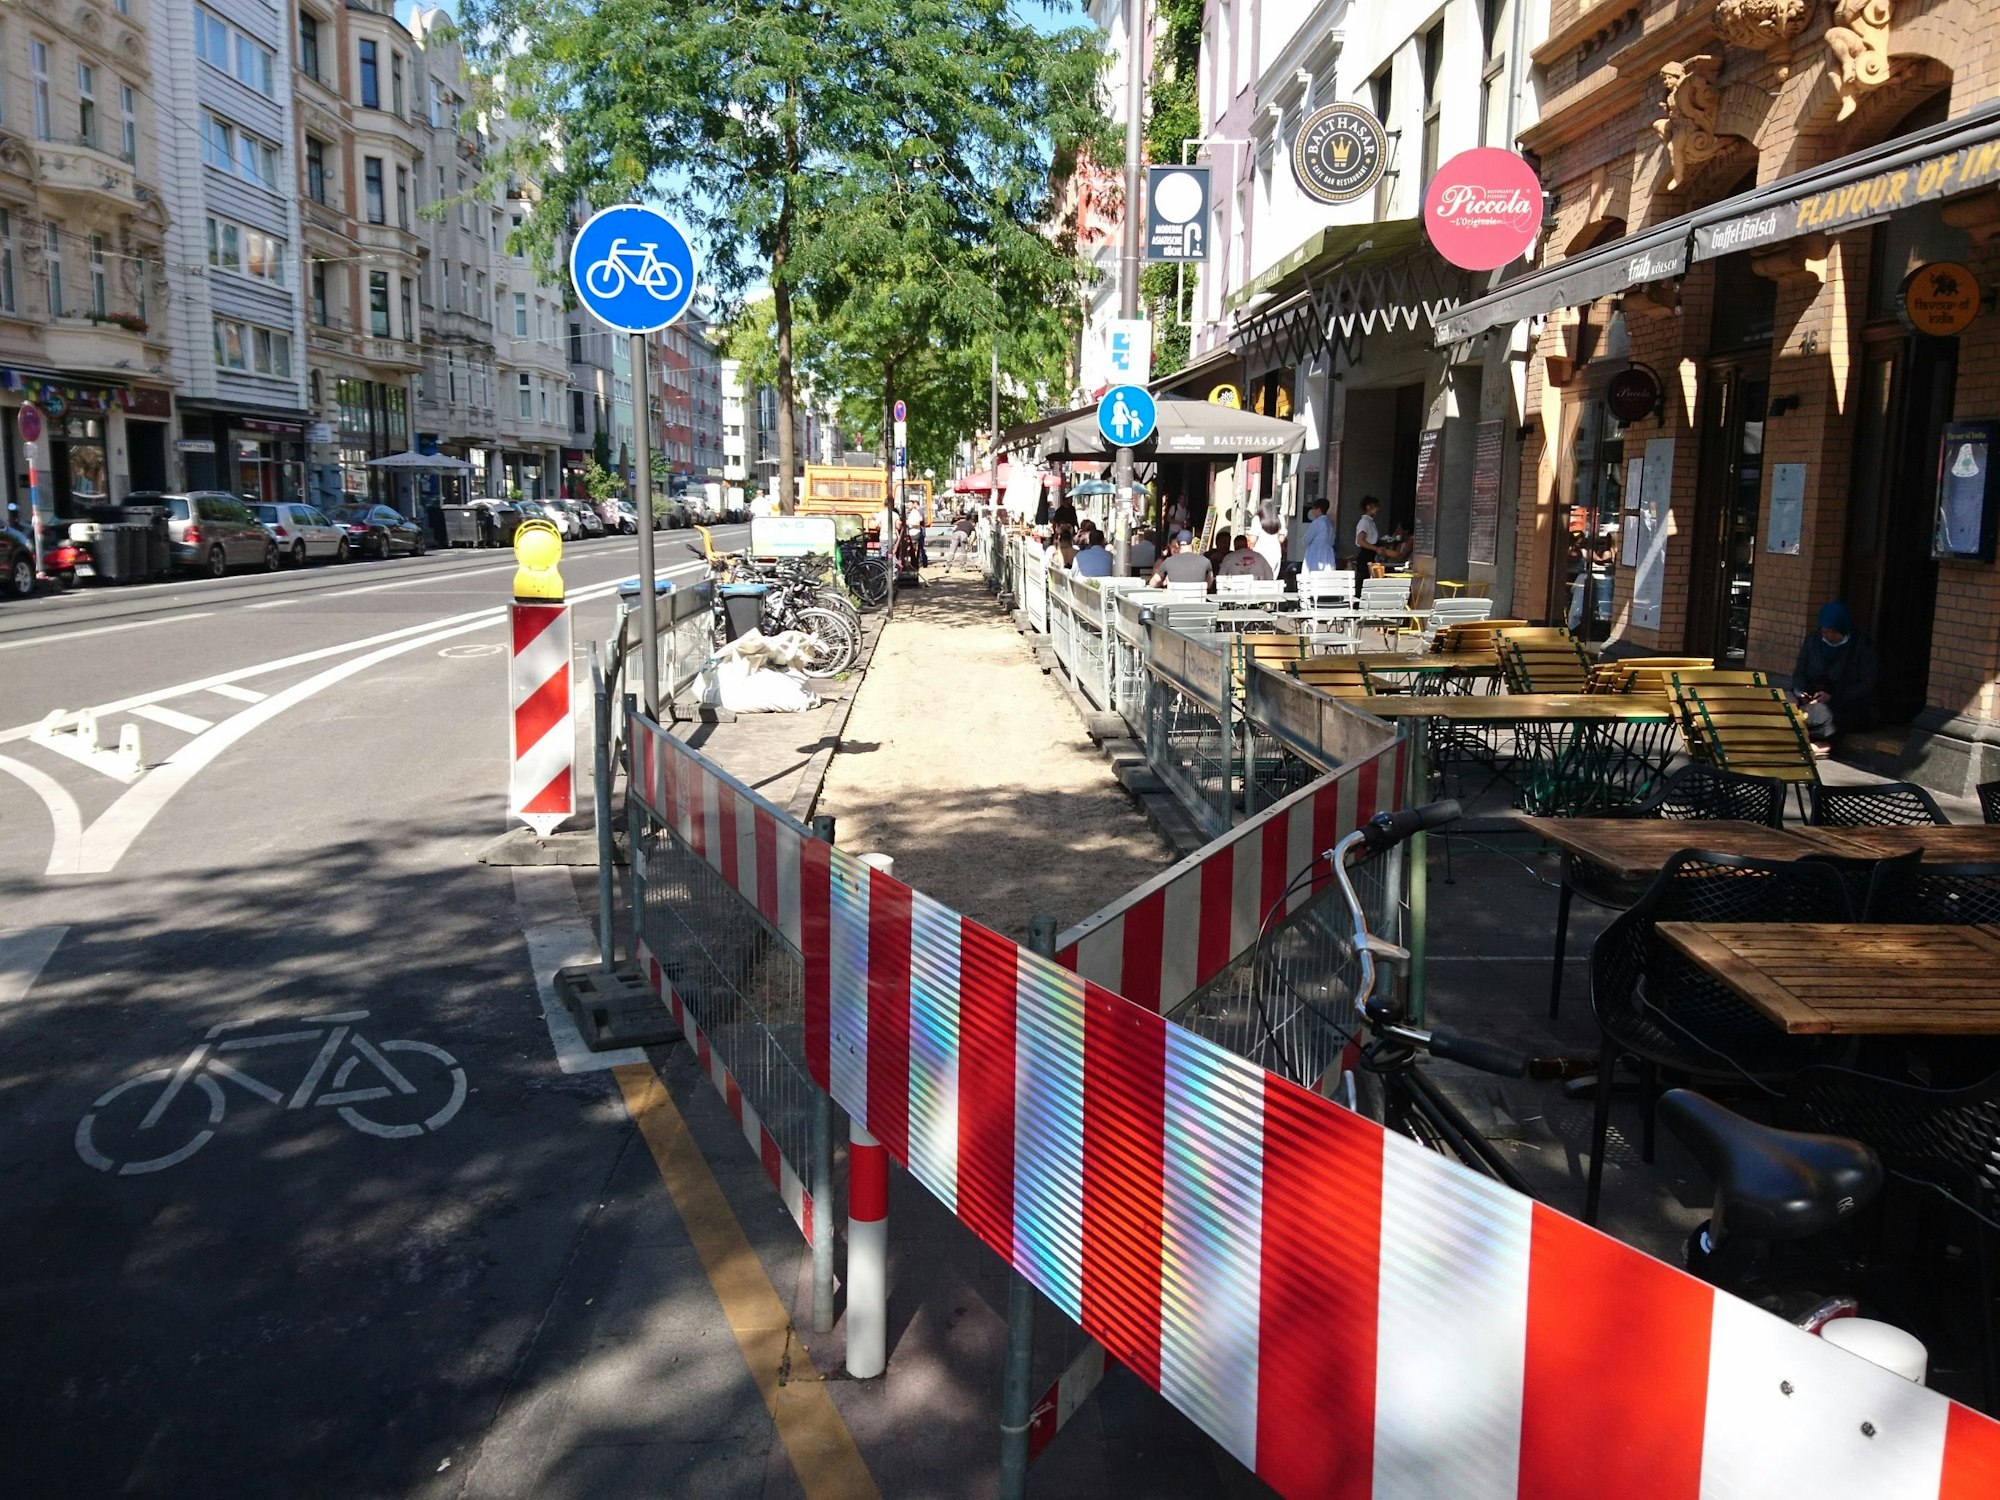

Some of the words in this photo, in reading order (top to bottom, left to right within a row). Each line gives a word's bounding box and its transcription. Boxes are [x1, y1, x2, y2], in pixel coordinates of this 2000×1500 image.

[1307, 116, 1375, 156] BALTHASAR
[1312, 164, 1323, 179] CAFE
[1323, 175, 1336, 186] BAR
[1336, 165, 1369, 187] RESTAURANT
[1795, 171, 1909, 229] FLAVOUR
[1916, 152, 1959, 197] OF
[1436, 184, 1531, 218] Piccola
[1155, 224, 1184, 235] MODERNE
[1151, 235, 1183, 246] ASIATISCHE
[1650, 258, 1678, 275] KÖLSCH
[1213, 435, 1285, 446] BALTHASAR
